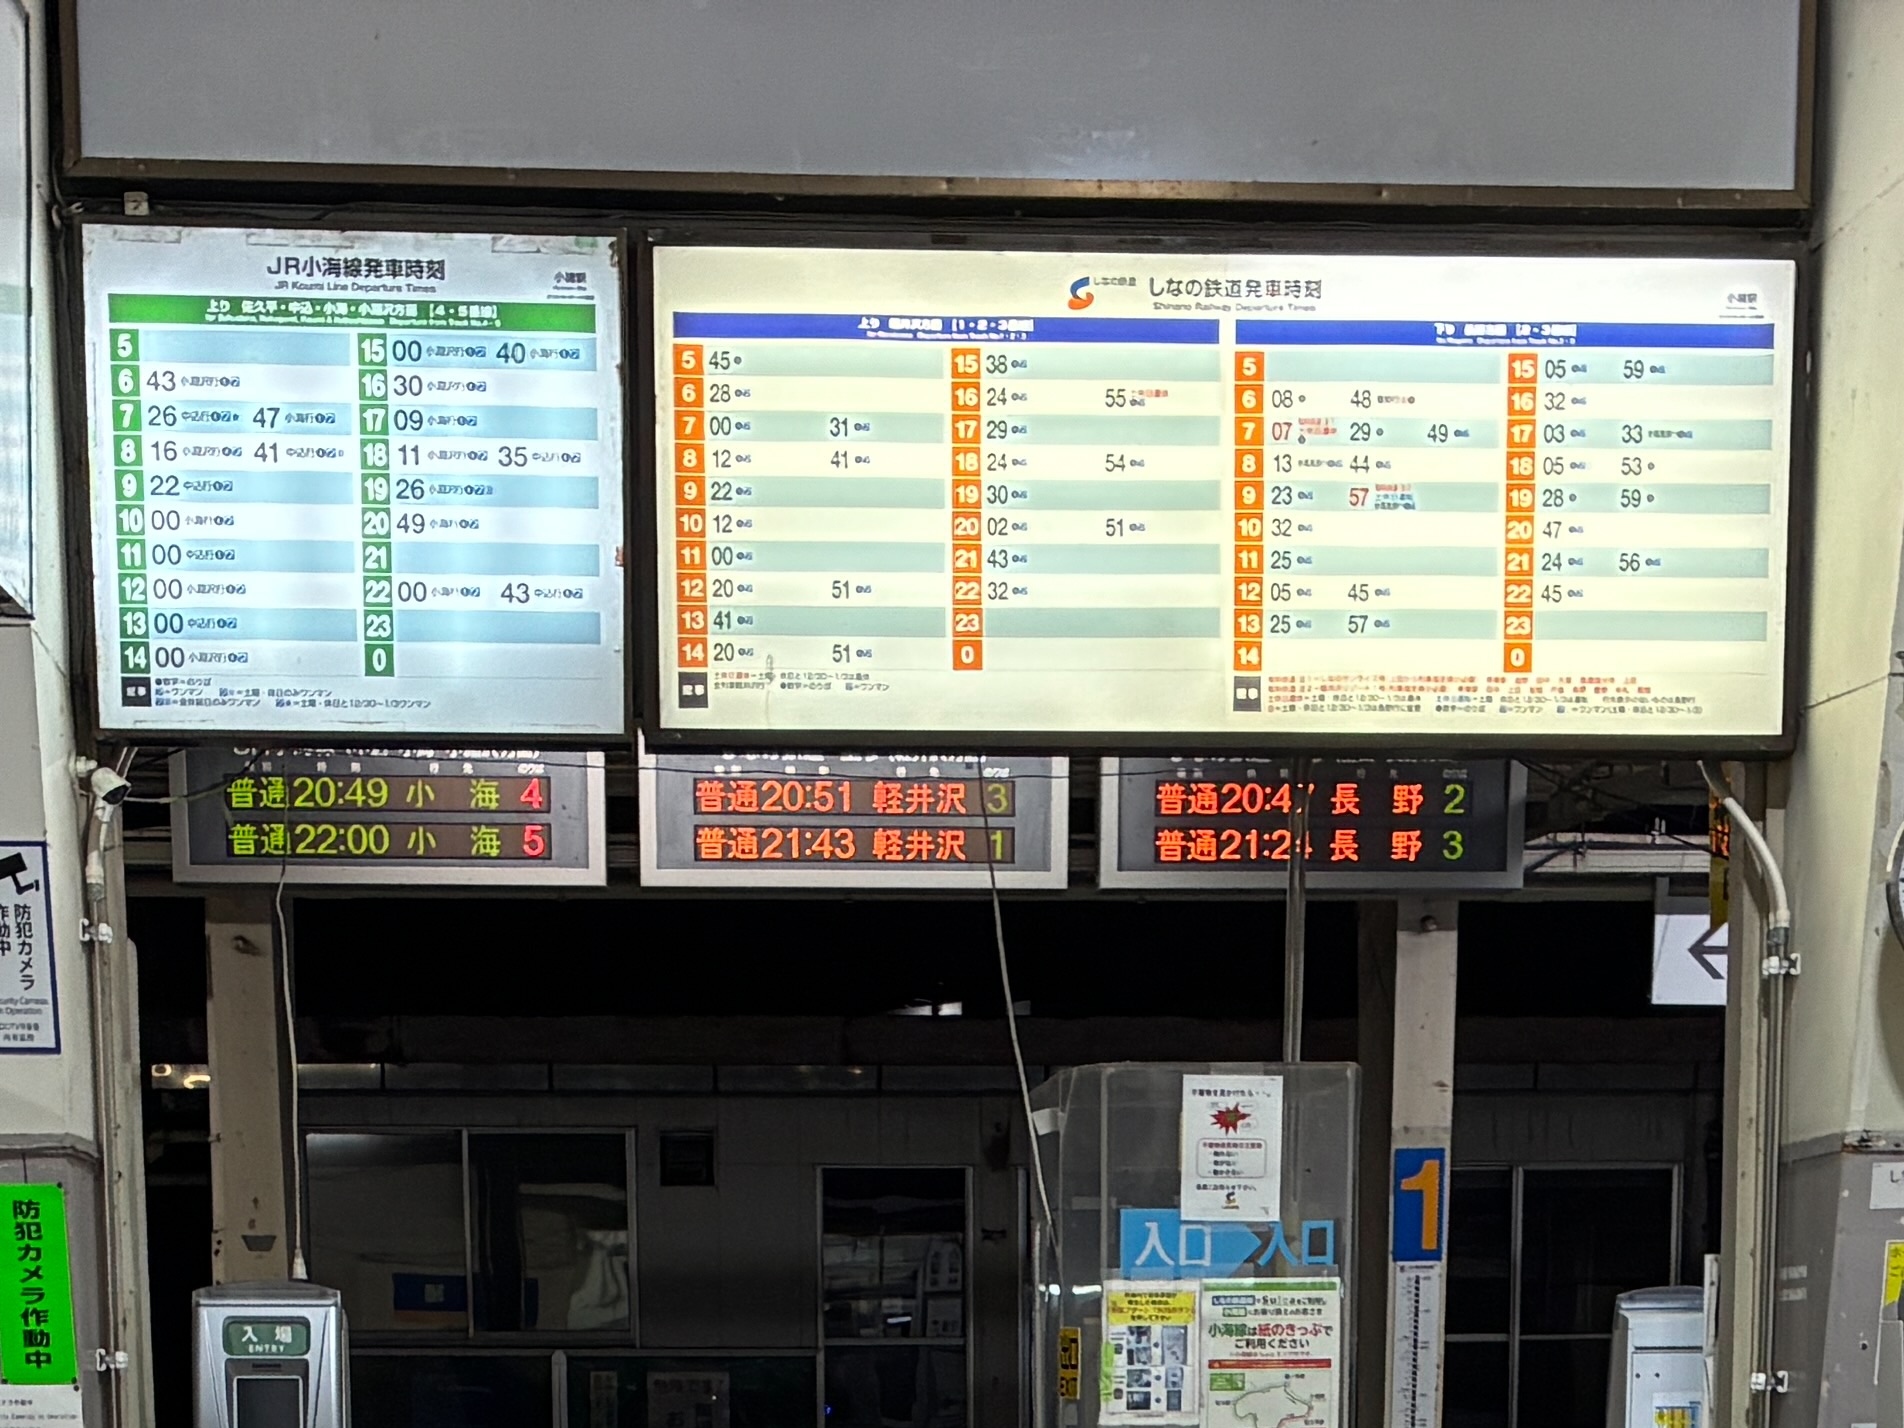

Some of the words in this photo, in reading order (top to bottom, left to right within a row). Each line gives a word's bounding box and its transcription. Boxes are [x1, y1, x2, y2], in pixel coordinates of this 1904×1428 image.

[119, 335, 132, 356] 5
[682, 351, 694, 370] 5
[709, 352, 730, 371] 45
[1512, 360, 1535, 379] 15
[1544, 359, 1566, 379] 05
[1623, 360, 1644, 380] 59
[118, 370, 133, 392] 6
[146, 371, 176, 391] 43
[682, 384, 695, 403] 6
[709, 385, 730, 403] 28
[1511, 394, 1533, 412] 16
[1544, 392, 1566, 410] 32
[122, 406, 133, 427] 7
[147, 405, 177, 428] 26
[253, 408, 280, 429] 47
[683, 417, 694, 435] 7
[710, 418, 731, 436] 00
[830, 418, 849, 437] 31
[1511, 425, 1533, 444] 17
[1544, 425, 1565, 443] 03
[1622, 425, 1642, 444] 33
[121, 440, 137, 461] 8
[152, 441, 177, 463] 16
[255, 442, 278, 463] 41
[683, 448, 696, 467] 8
[713, 450, 731, 468] 12
[831, 452, 849, 469] 41
[122, 475, 138, 496] 9
[150, 476, 179, 496] 22
[119, 511, 144, 532] 10
[151, 510, 180, 531] 00
[121, 546, 141, 566] 11
[153, 545, 181, 565] 00
[122, 579, 146, 600] 12
[154, 579, 183, 600] 00
[124, 613, 147, 634] 13
[154, 614, 183, 634] 00
[124, 647, 148, 669] 14
[155, 647, 184, 668] 00
[227, 777, 288, 809] 普通
[294, 776, 389, 809] 20:49
[519, 777, 543, 808] 4
[696, 780, 759, 813] 普通
[760, 780, 851, 813] 20:51
[872, 780, 966, 814] 軽井沢
[986, 782, 1008, 813] 3
[1156, 783, 1218, 815] 普通
[1444, 784, 1464, 813] 2
[228, 824, 289, 856] 普通
[294, 822, 390, 855] 22:00
[521, 824, 544, 856] 5
[696, 827, 759, 860] 普通
[760, 828, 855, 860] 21:43
[872, 828, 966, 861] 軽井沢
[991, 830, 1002, 859] 1
[1156, 830, 1217, 862] 普通
[1443, 830, 1463, 860] 3
[14, 902, 35, 992] 防犯カメラ
[1401, 1160, 1440, 1250] 1
[1135, 1222, 1211, 1266] 入口
[1257, 1220, 1334, 1266] 入口
[12, 1198, 52, 1370] 防犯カメラ作動中
[241, 1325, 293, 1344] 入場
[1235, 1338, 1310, 1349] ご利用ください
[247, 1344, 285, 1354] ENTRY
